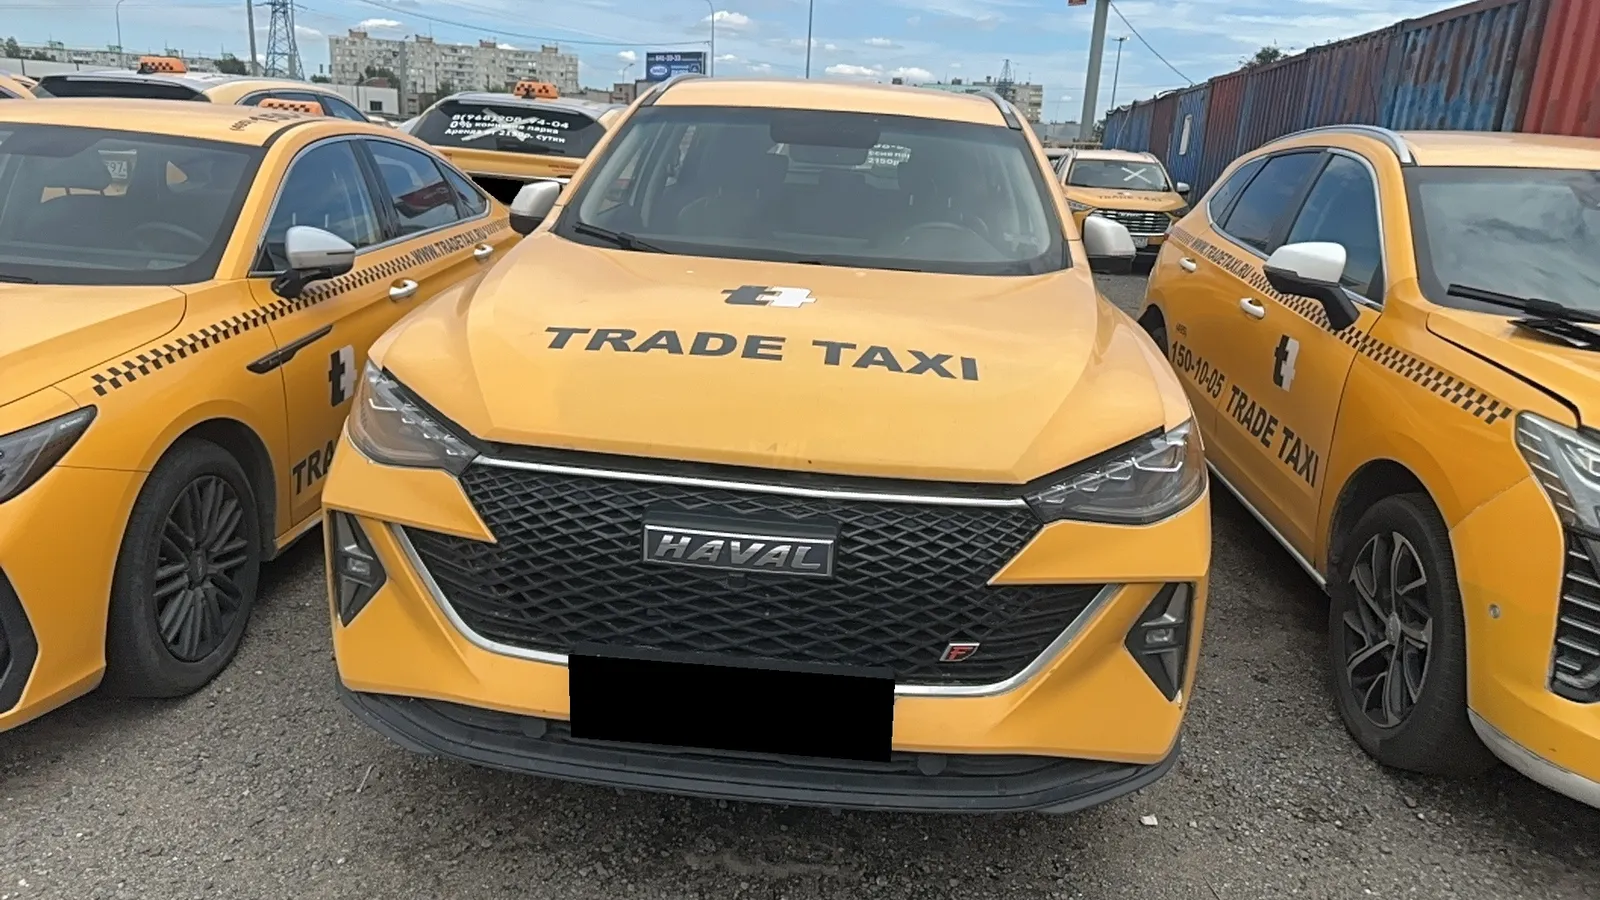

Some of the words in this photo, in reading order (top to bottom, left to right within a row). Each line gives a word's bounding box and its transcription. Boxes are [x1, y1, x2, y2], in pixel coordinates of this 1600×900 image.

[527, 126, 559, 135] парка
[536, 134, 566, 143] сутки
[410, 226, 488, 265] WWW.TRADETAXI.RU
[545, 326, 786, 361] TRADE
[811, 339, 980, 381] TAXI
[1171, 340, 1226, 399] 150-10-05
[1225, 384, 1279, 449] TRADE
[1277, 426, 1320, 488] TAXI
[653, 534, 821, 571] HAVAL
